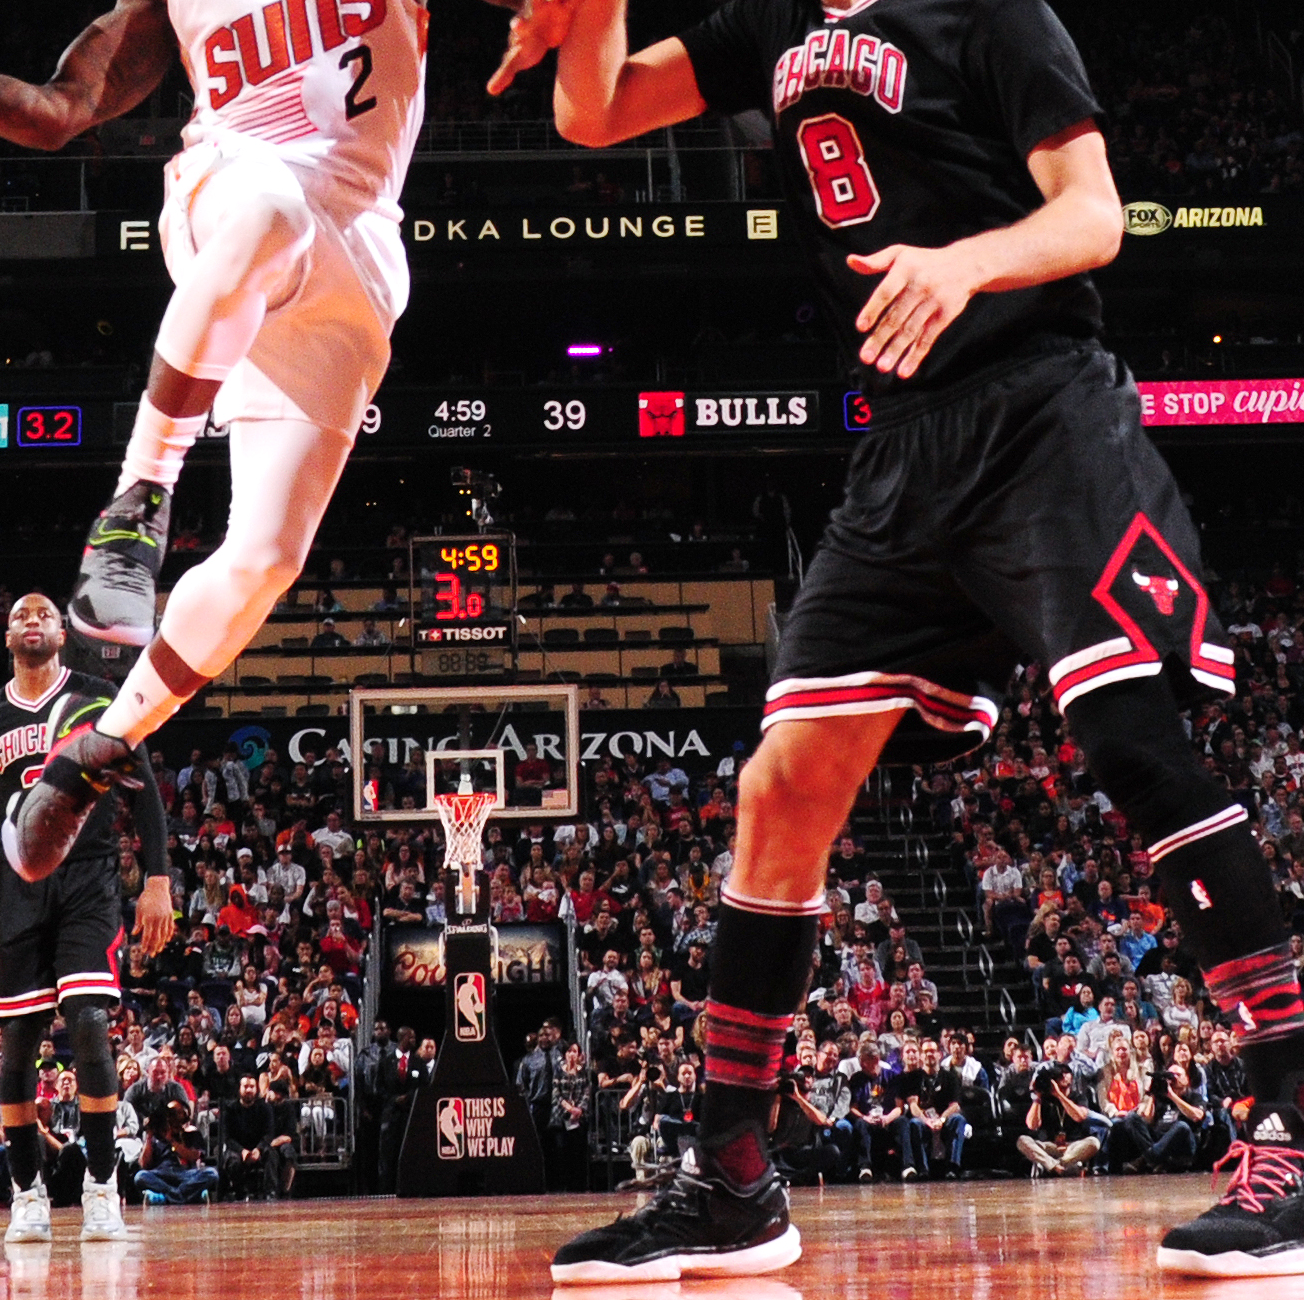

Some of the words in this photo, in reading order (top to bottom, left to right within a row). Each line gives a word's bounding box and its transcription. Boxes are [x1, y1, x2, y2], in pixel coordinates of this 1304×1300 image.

[338, 44, 377, 121] 2
[797, 112, 881, 229] 8
[1128, 208, 1159, 222] FOX
[1173, 207, 1263, 228] ARIZONA
[414, 220, 500, 241] DKA
[523, 215, 705, 241] LOUNGE
[434, 400, 487, 421] 4:59
[695, 397, 808, 427] BULLS
[1164, 392, 1226, 415] STOP
[25, 411, 74, 440] 3.2
[543, 400, 586, 430] 39
[428, 425, 475, 439] Quarter
[483, 425, 492, 438] 2
[440, 543, 499, 572] 4:59
[434, 572, 483, 620] 3.0
[443, 626, 508, 641] TISSOT
[446, 924, 488, 935] SPALDING
[464, 1097, 492, 1118] THIS
[493, 1097, 506, 1117] IS
[465, 1117, 493, 1137] WHY
[467, 1137, 486, 1158] WE
[486, 1136, 515, 1157] PLAY
